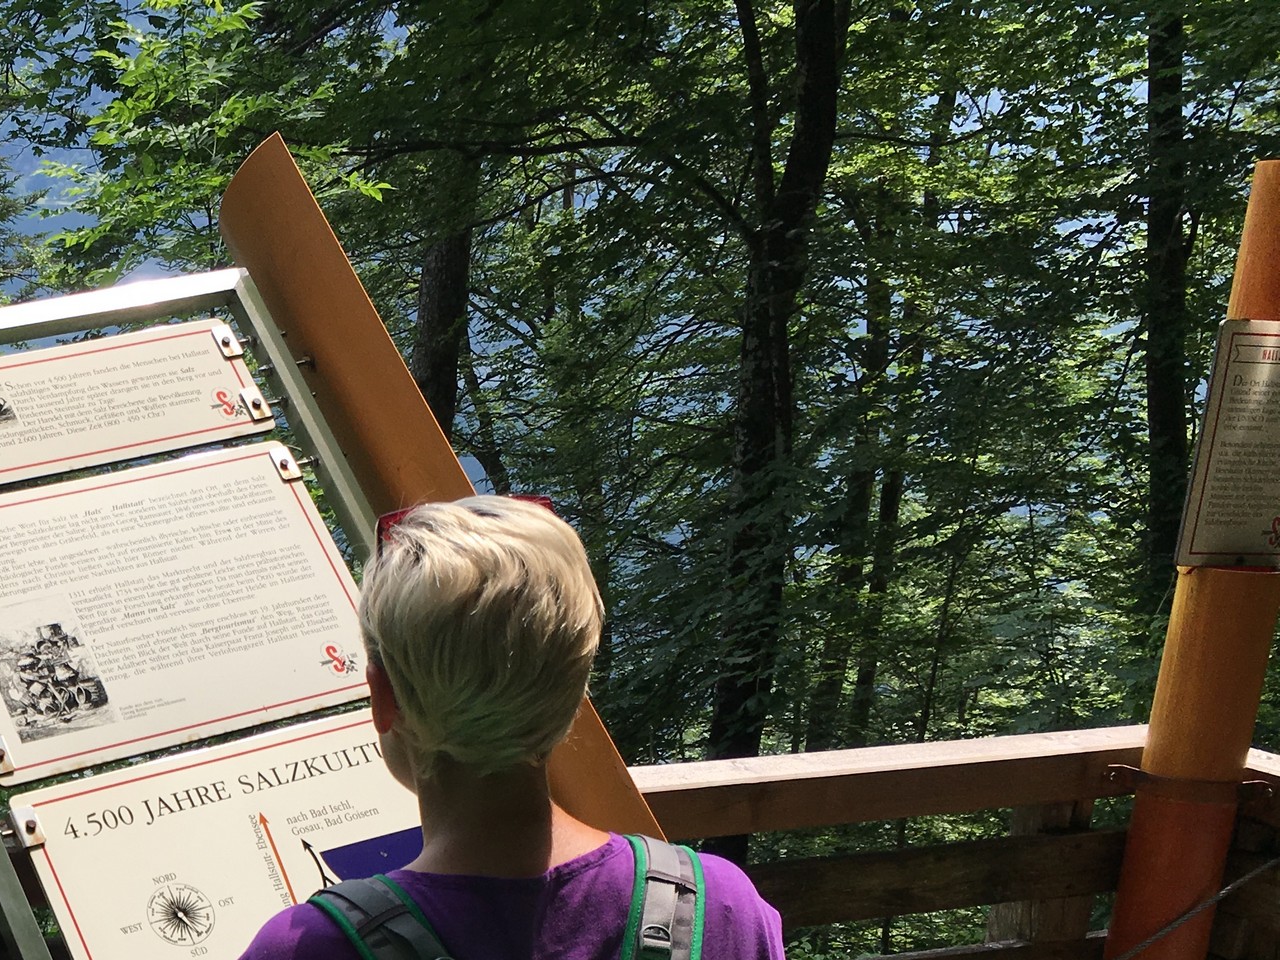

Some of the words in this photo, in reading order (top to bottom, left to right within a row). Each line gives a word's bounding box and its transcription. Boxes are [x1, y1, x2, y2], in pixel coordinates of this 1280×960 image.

[68, 371, 92, 381] Jahren
[93, 366, 118, 375] fanden
[132, 357, 168, 368] Menschen
[182, 349, 210, 359] Hallstatt
[13, 397, 36, 405] Durch
[38, 388, 86, 402] Verdampfung
[101, 380, 129, 389] Wassers
[131, 374, 168, 384] gewannen
[65, 395, 85, 404] Jahre
[177, 375, 194, 384] Berg
[37, 415, 63, 424] Handel
[66, 427, 87, 435] Diese
[156, 625, 187, 636] Friedrich
[150, 659, 183, 672] während
[267, 633, 298, 644] Hallstatt
[63, 805, 135, 840] 4.500
[142, 781, 231, 826] JAHRE
[236, 742, 383, 795] SALZKULT
[286, 811, 308, 824] nach
[309, 806, 328, 819] Bad
[329, 800, 354, 814] Ischl,
[324, 816, 343, 828] Bad
[344, 808, 380, 822] Goisern
[248, 814, 267, 850] Ebensee
[152, 873, 177, 886] NORD
[218, 897, 235, 908] OST
[120, 923, 144, 936] WEST
[190, 946, 208, 958] SÜD
